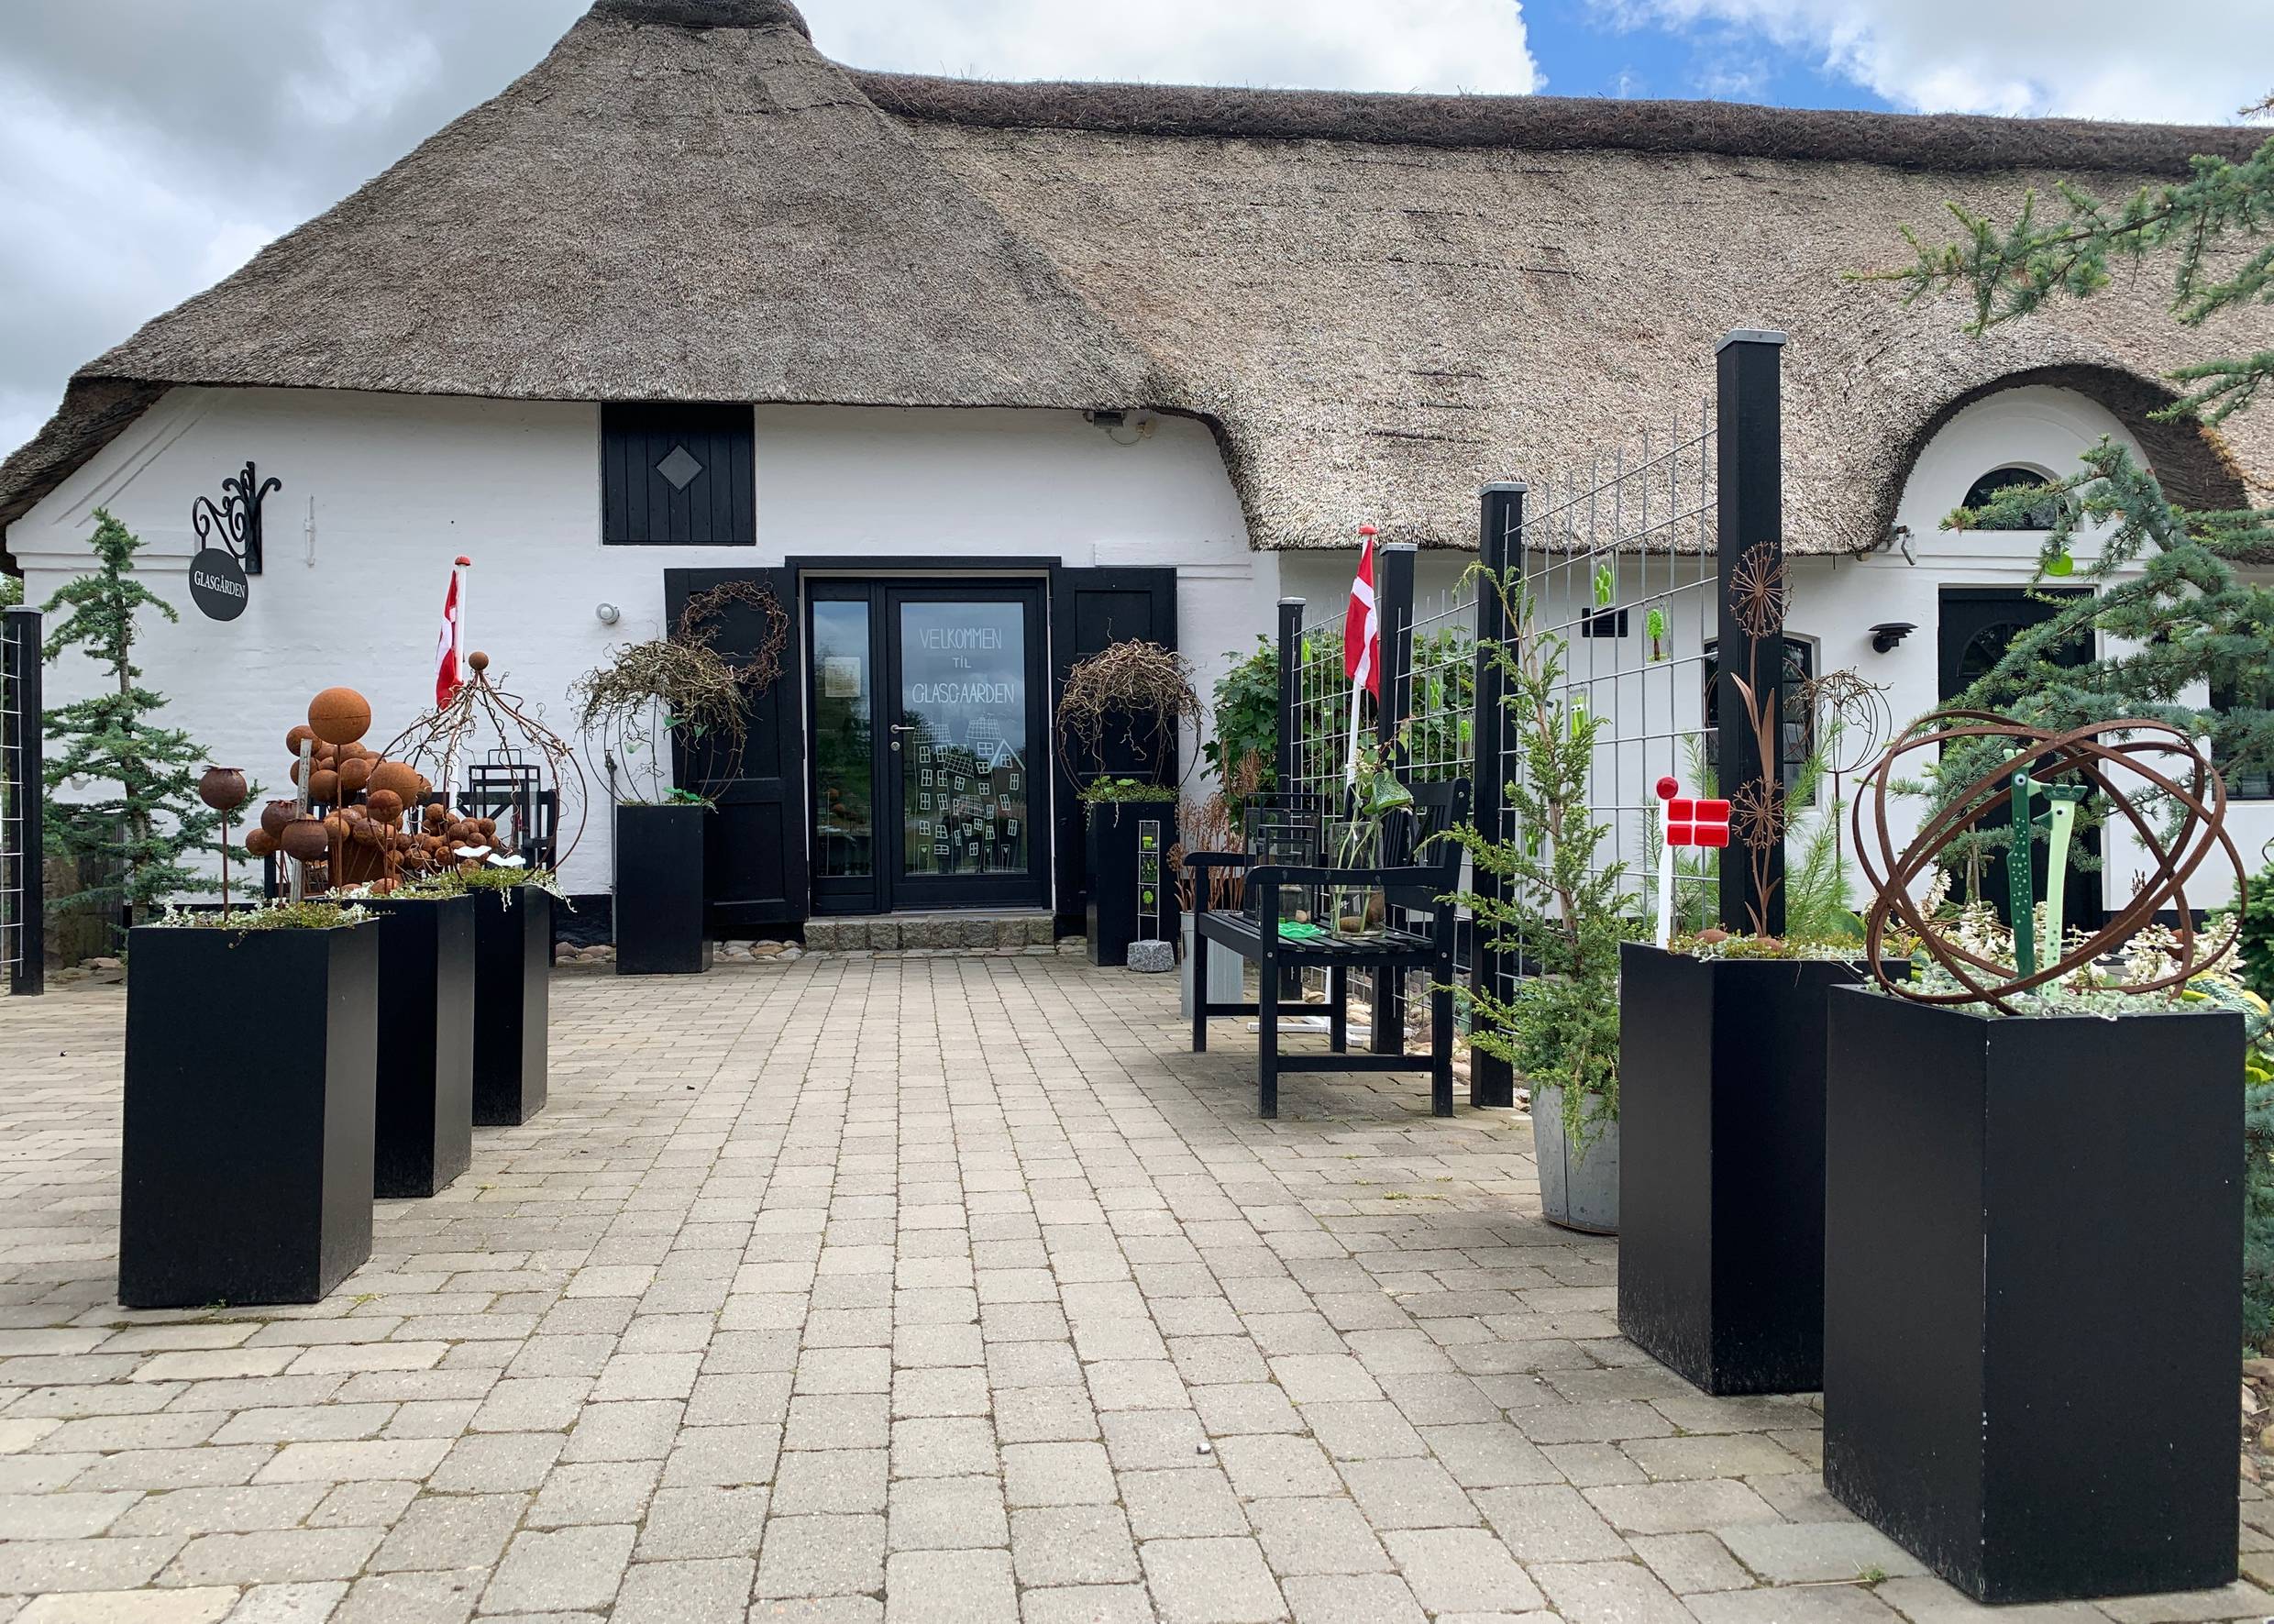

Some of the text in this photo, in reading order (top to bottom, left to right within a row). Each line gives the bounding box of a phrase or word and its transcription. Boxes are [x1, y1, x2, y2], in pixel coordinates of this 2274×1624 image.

[194, 570, 246, 599] GLASGÅRDEN
[919, 627, 1002, 649] VELKOMMEN
[911, 682, 1014, 703] GLASGAARDEN
